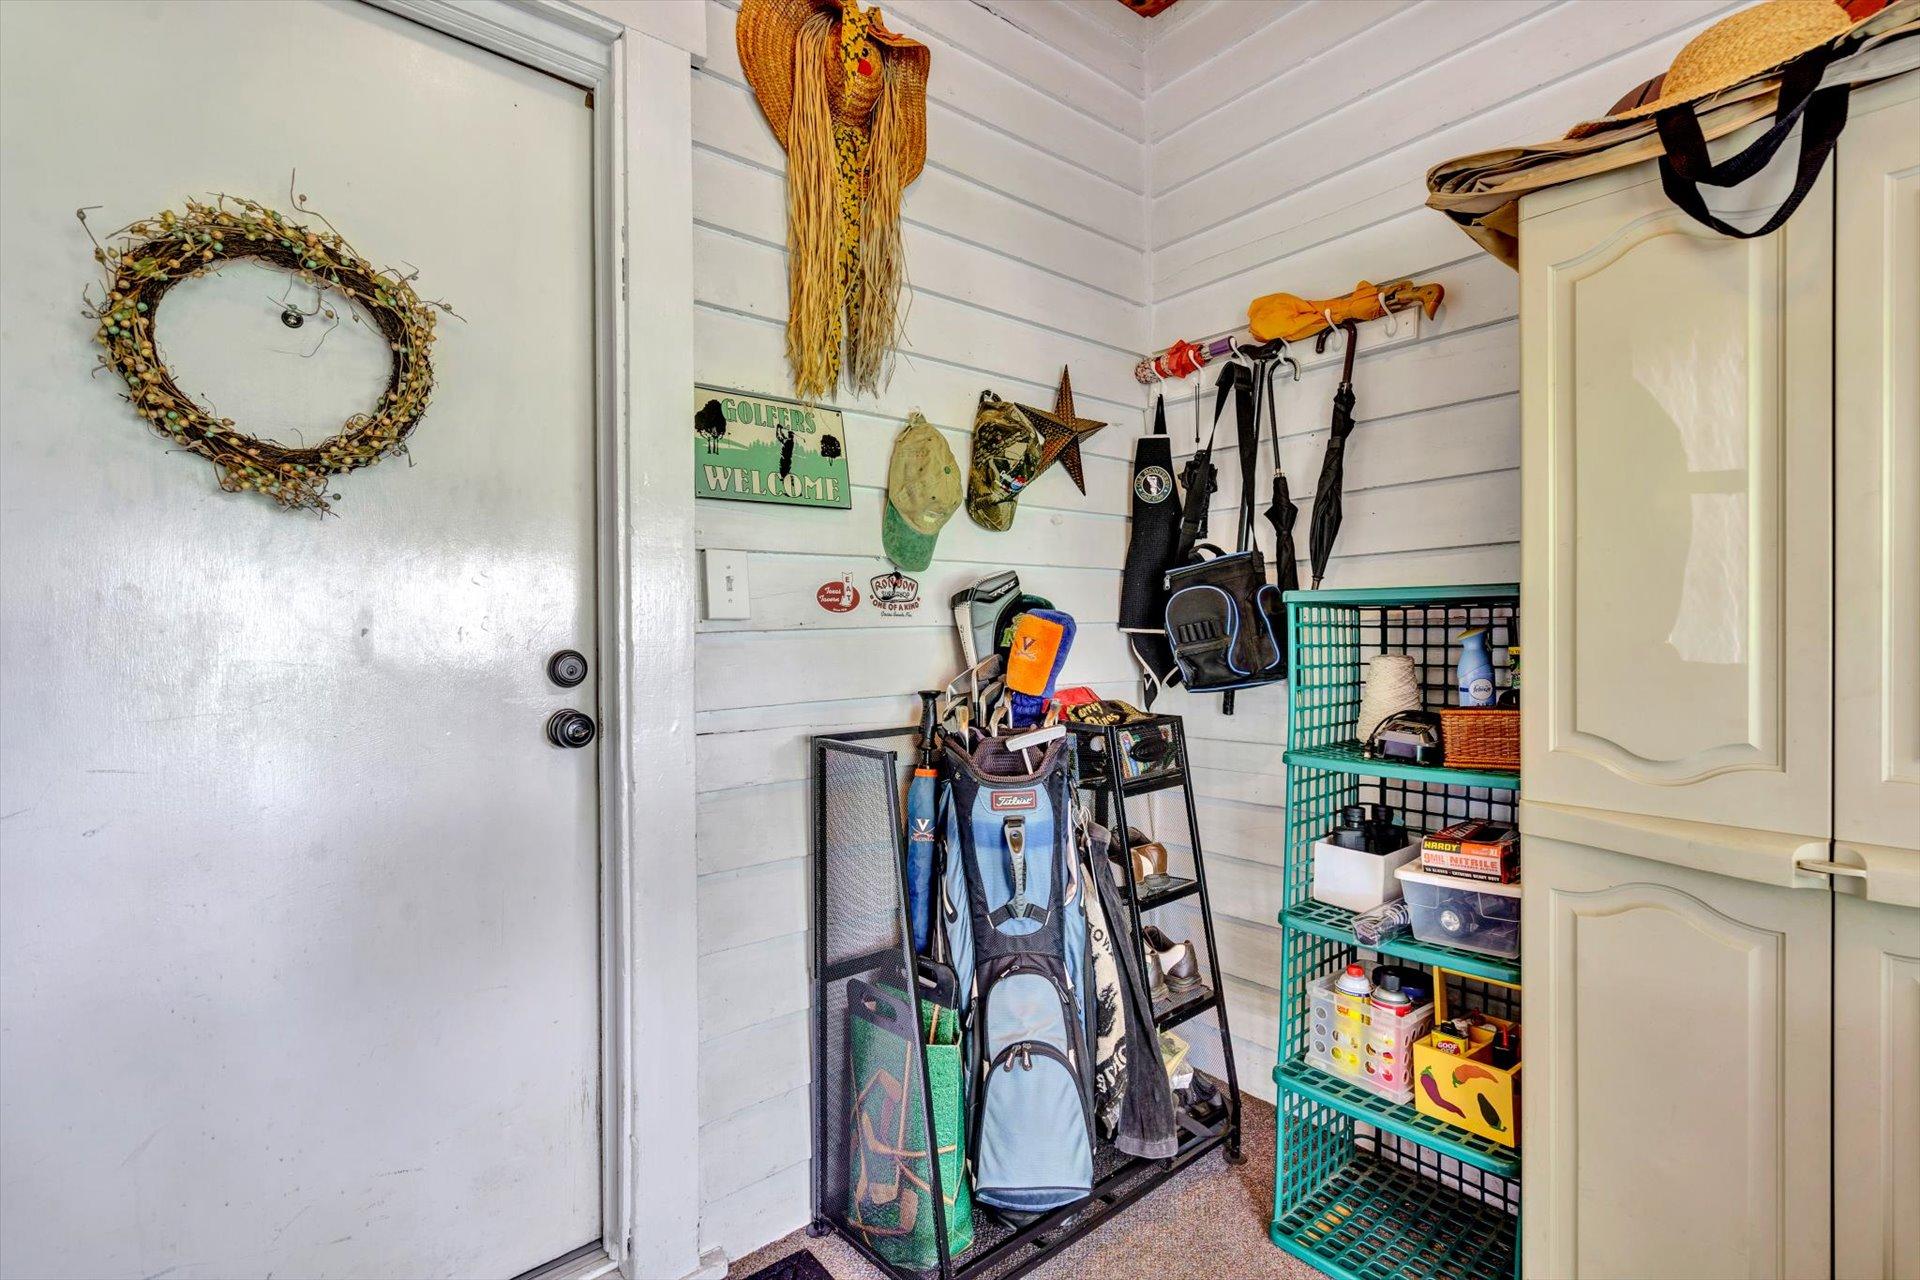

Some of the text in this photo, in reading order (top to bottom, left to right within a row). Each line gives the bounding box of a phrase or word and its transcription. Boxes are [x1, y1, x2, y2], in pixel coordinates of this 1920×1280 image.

[721, 398, 817, 434] GOLFERS
[703, 464, 840, 502] WELCOME
[873, 600, 887, 610] ONE
[889, 603, 898, 611] OF
[898, 603, 904, 611] A
[1424, 841, 1457, 852] HARDY
[1450, 856, 1498, 868] NITRILE
[1438, 1042, 1458, 1050] GOOF
